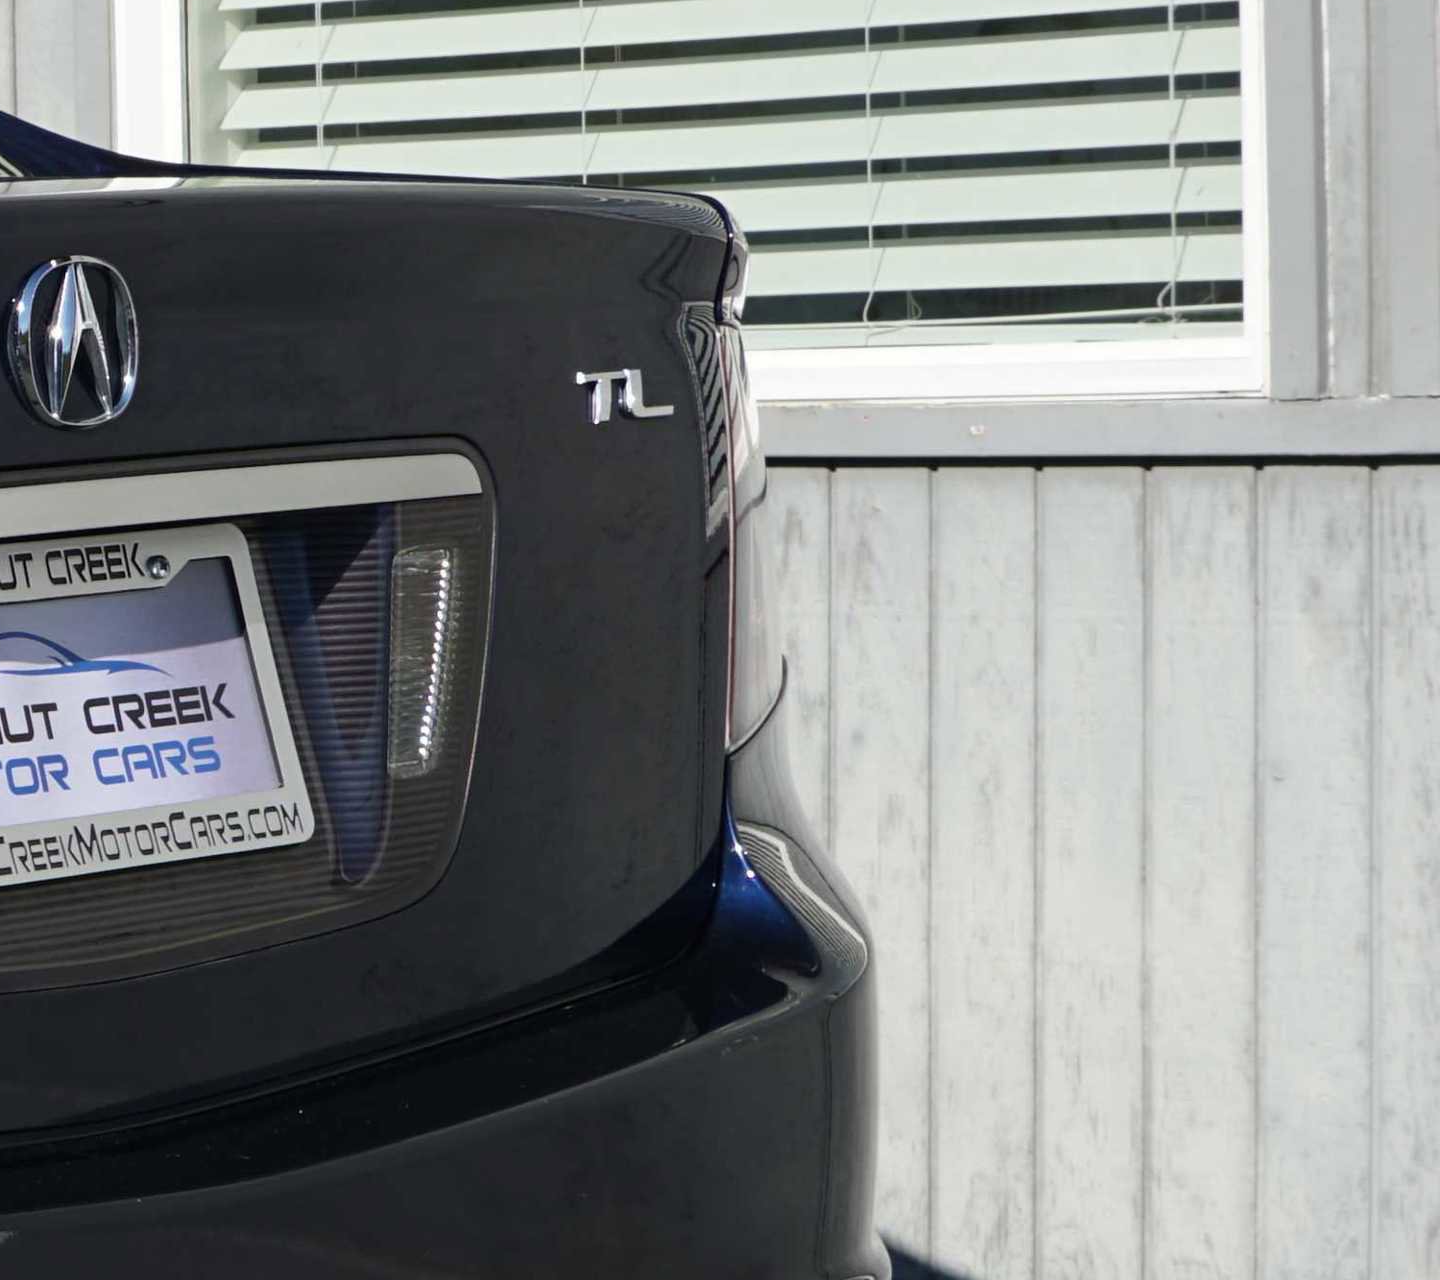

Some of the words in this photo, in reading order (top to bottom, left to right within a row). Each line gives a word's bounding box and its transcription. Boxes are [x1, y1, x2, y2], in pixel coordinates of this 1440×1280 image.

[575, 368, 675, 425] TL
[45, 541, 146, 587] CREEK
[82, 682, 236, 734] CREEK
[93, 735, 222, 786] CARS
